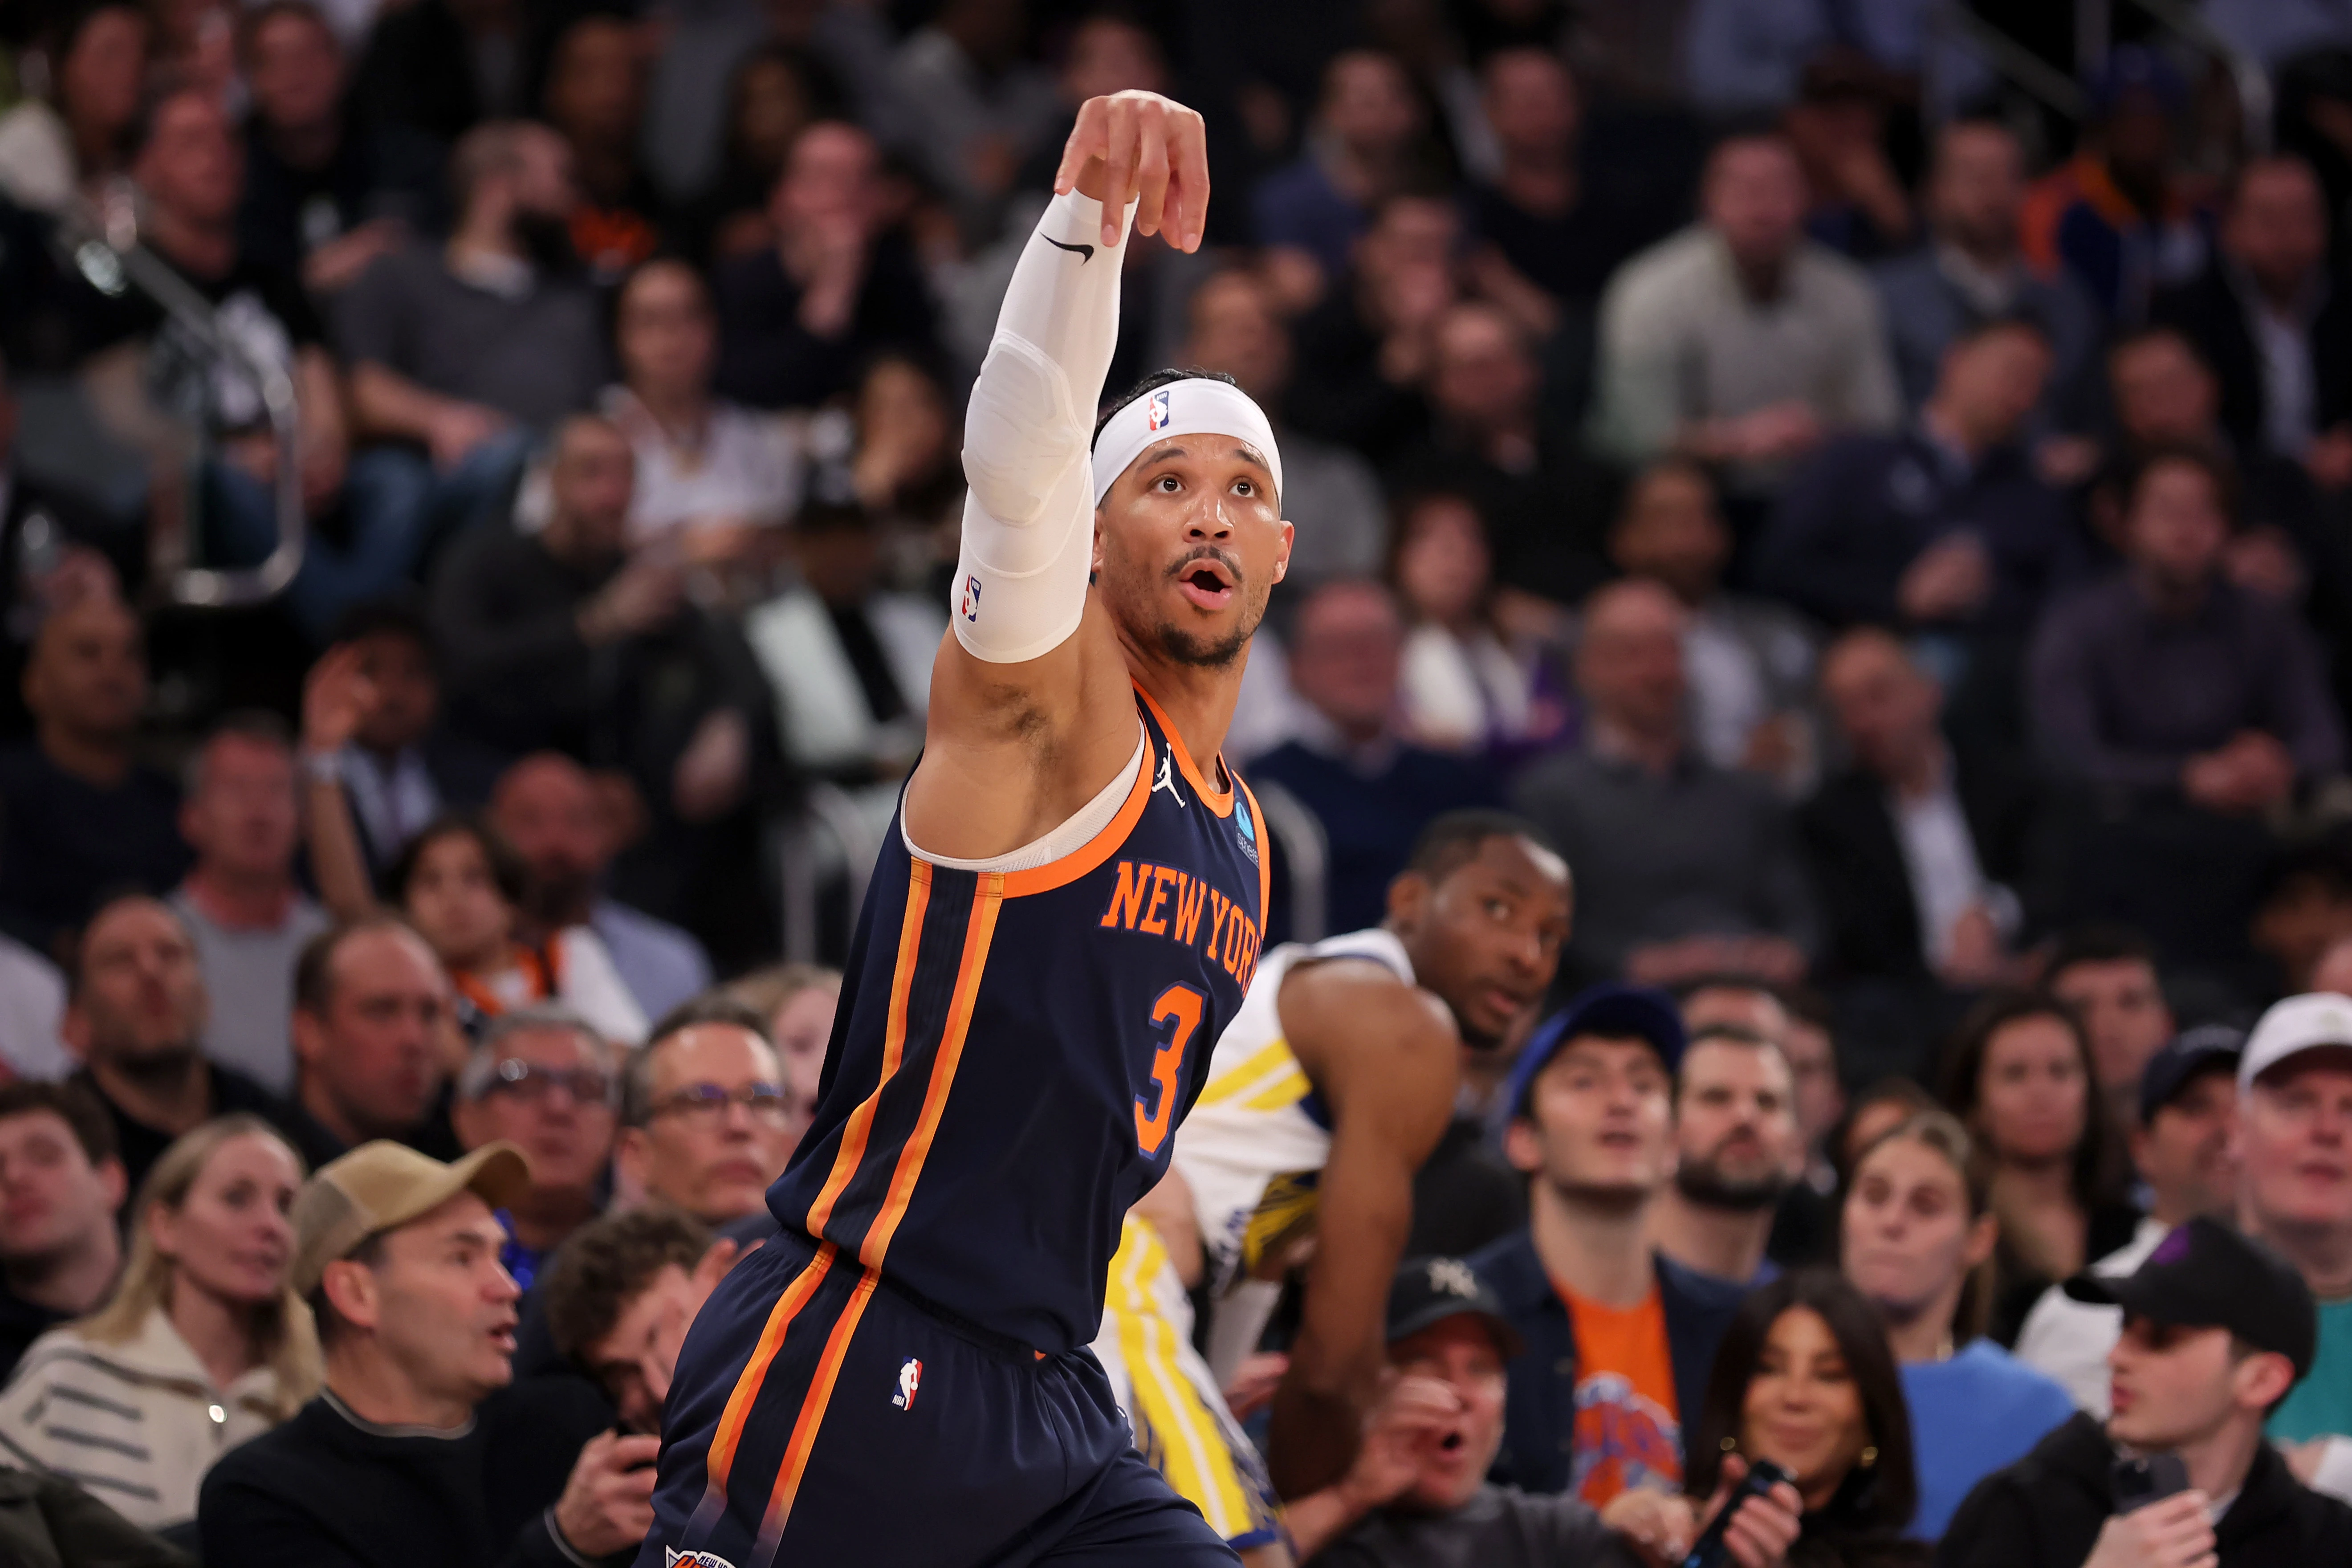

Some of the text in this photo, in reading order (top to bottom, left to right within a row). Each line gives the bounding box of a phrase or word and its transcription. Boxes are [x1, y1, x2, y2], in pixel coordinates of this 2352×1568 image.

[1100, 860, 1207, 946] NEW
[1135, 980, 1209, 1161] 3
[892, 1394, 905, 1407] NBA
